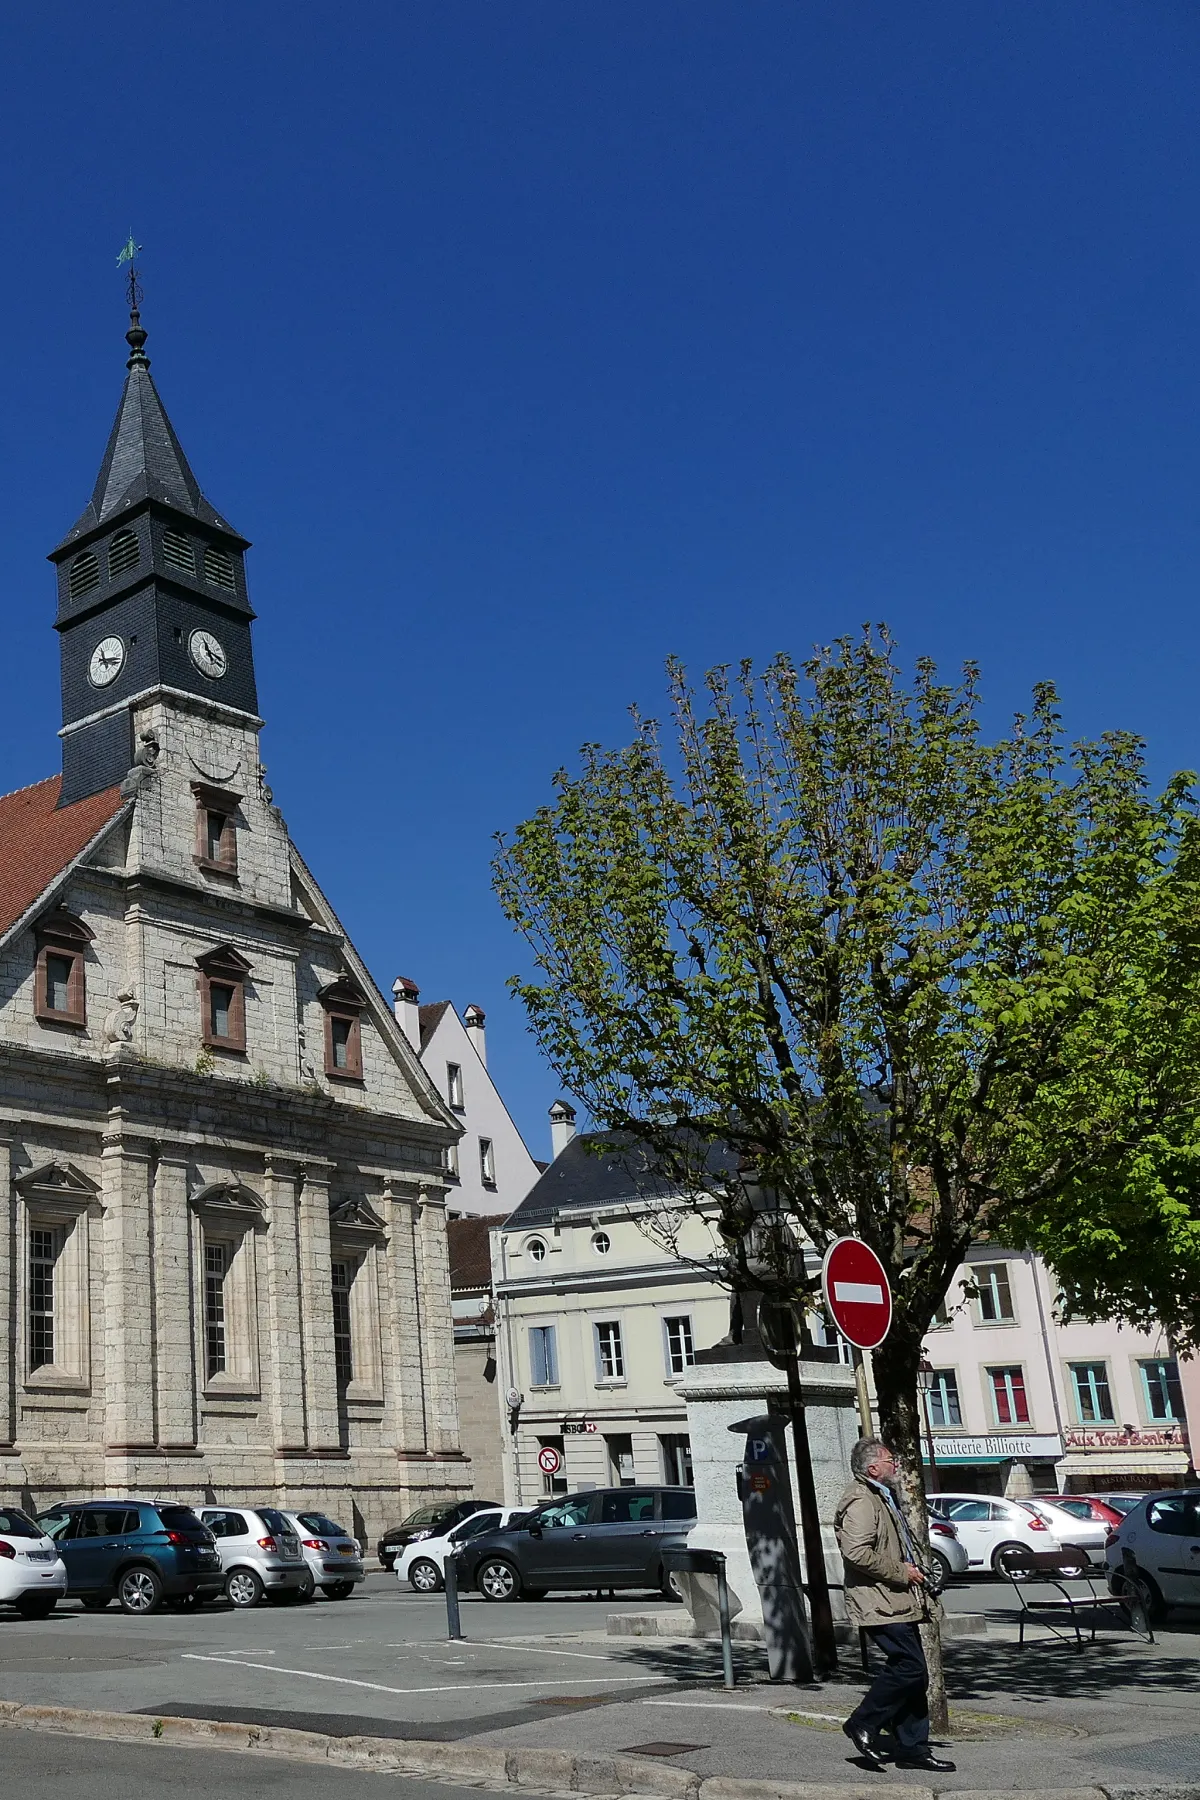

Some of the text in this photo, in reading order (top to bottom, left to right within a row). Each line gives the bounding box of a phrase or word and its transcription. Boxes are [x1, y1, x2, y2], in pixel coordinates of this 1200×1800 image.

[560, 1424, 584, 1434] HSBC
[924, 1438, 1031, 1454] scuiterie Billiotte
[1065, 1432, 1095, 1446] Aux
[1096, 1431, 1128, 1445] Trois
[752, 1440, 766, 1460] P
[1101, 1475, 1153, 1486] RESTAURANT
